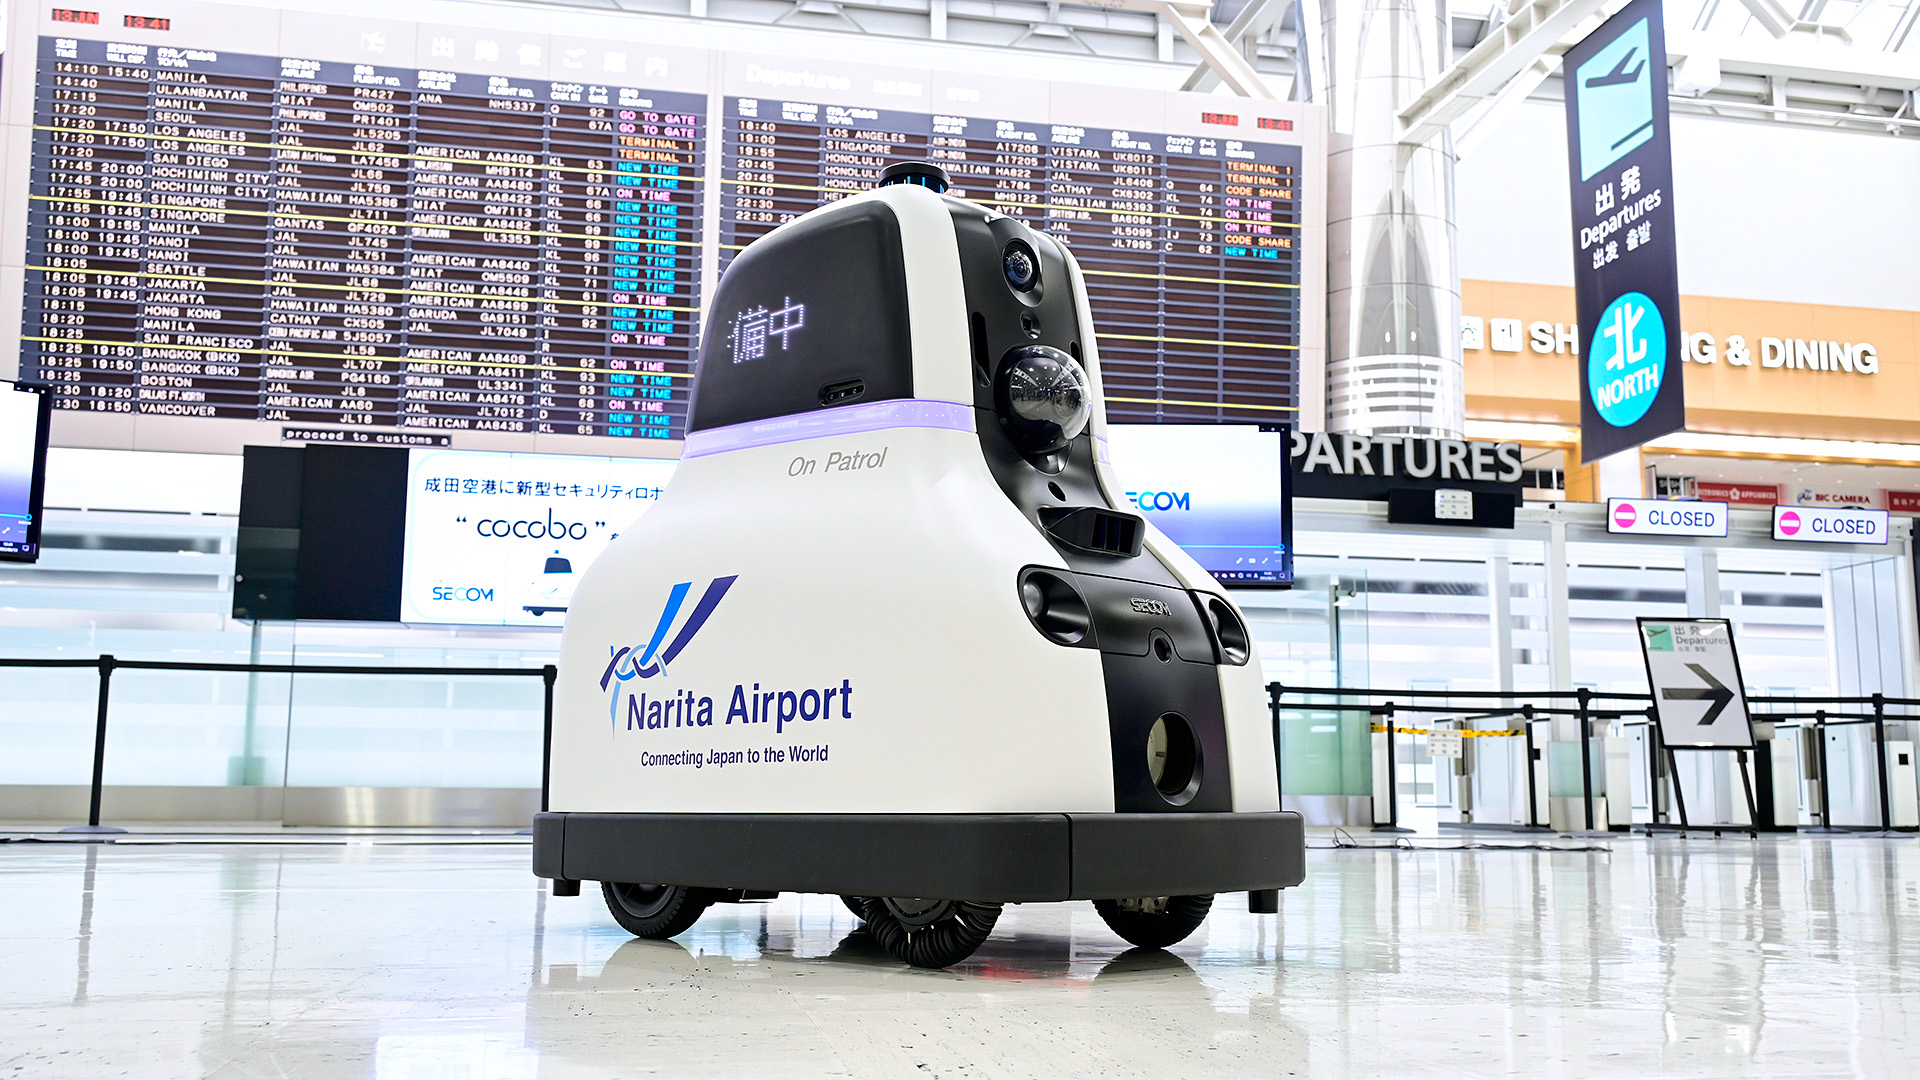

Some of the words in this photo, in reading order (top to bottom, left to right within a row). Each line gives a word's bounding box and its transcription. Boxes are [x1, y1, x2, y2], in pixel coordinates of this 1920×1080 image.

[54, 9, 73, 22] 13
[58, 63, 98, 74] 14:10
[109, 67, 148, 78] 15:40
[57, 76, 97, 88] 14:40
[157, 72, 207, 83] MANILA
[56, 90, 96, 102] 17:15
[157, 85, 247, 100] ULAANBAATAR
[156, 98, 206, 110] MANILA
[280, 96, 313, 106] MIAT
[55, 104, 96, 115] 17:20
[55, 118, 94, 129] 17:20
[156, 112, 196, 124] SEOUL
[620, 110, 636, 120] GO
[643, 112, 658, 122] TO
[665, 114, 695, 125] GATE
[106, 122, 145, 133] 17:50
[280, 123, 303, 132] JAL
[740, 121, 775, 132] 18:40
[155, 126, 179, 136] LOS
[188, 128, 246, 141] ANGELES
[740, 134, 775, 144] 19:00
[827, 128, 848, 138] LOS
[855, 131, 905, 142] ANGELES
[620, 136, 679, 150] TERMINAL
[827, 141, 890, 154] SINGAPORE
[416, 147, 479, 159] AMERICAN
[1052, 148, 1100, 158] VISTARA
[52, 160, 92, 171] 17:45
[154, 154, 178, 164] SAN
[187, 156, 228, 168] DIEGO
[826, 154, 884, 166] HONOLULU
[102, 163, 143, 175] 20:00
[618, 162, 642, 172] NEW
[649, 164, 678, 175] TIME
[1227, 162, 1279, 174] TERMINAL
[152, 167, 227, 181] HOCHIMINH
[236, 173, 269, 184] CITY
[51, 187, 90, 198] 17:55
[617, 188, 633, 198] ON
[640, 190, 670, 201] TIME
[737, 186, 773, 196] 21:40
[1051, 184, 1092, 194] CATHAY
[1226, 186, 1252, 196] CODE
[1260, 188, 1291, 199] SHARE
[1595, 164, 1641, 217] 出発
[102, 191, 142, 202] 19:45
[152, 194, 226, 208] SINGAPORE
[1051, 197, 1106, 208] HAWAIIAN
[276, 204, 299, 214] JAL
[414, 200, 446, 210] MIAT
[1226, 198, 1240, 206] ON
[1246, 199, 1272, 210] TIME
[49, 216, 89, 227] 18:00
[151, 209, 225, 223] SINGAPORE
[736, 211, 772, 221] 22:30
[1580, 188, 1662, 250] Departures
[100, 219, 140, 230] 19:55
[275, 218, 324, 230] QANTAS
[48, 230, 88, 240] 18:00
[100, 233, 139, 244] 19:45
[149, 236, 189, 248] HANOI
[148, 250, 188, 261] HANOI
[615, 255, 638, 264] NEW
[646, 257, 675, 267] TIME
[47, 257, 87, 268] 18:05
[273, 259, 338, 271] HAWAIIAN
[148, 264, 206, 276] SEATTLE
[46, 272, 86, 283] 18:05
[98, 275, 137, 286] 19:45
[147, 279, 205, 290] JAKARTA
[44, 300, 84, 310] 18:15
[613, 294, 629, 303] ON
[637, 295, 666, 306] TIME
[145, 306, 178, 316] HONG
[187, 309, 221, 319] KONG
[409, 309, 457, 319] GARUDA
[44, 314, 84, 324] 18:20
[270, 314, 320, 324] CATHAY
[582, 319, 597, 328] 92
[144, 320, 194, 331] MANILA
[727, 296, 803, 364] 備中
[43, 328, 83, 338] 18:25
[1604, 302, 1646, 371] 北
[144, 334, 169, 343] SAN
[178, 336, 253, 348] FRANCISCO
[94, 346, 134, 356] 19:50
[1726, 334, 1752, 367] &
[1760, 335, 1880, 375] DINING
[141, 376, 192, 387] BOSTON
[611, 374, 634, 383] NEW
[642, 376, 671, 386] TIME
[91, 387, 131, 398] 18:20
[268, 383, 291, 392] JAL
[1597, 363, 1659, 411] NORTH
[90, 401, 130, 411] 18:50
[267, 396, 332, 408] AMERICAN
[140, 404, 215, 416] VANCOUVER
[580, 412, 593, 421] 72
[286, 431, 344, 442] proceed
[354, 433, 369, 442] to
[377, 435, 433, 445] customs
[788, 456, 816, 477] On
[824, 446, 888, 473] Patrol
[1290, 431, 1523, 483] PARTURES
[1125, 491, 1190, 512] ECOM
[1815, 493, 1830, 502] BIC
[1832, 494, 1871, 504] CAMERA
[1649, 509, 1715, 528] CLOSED
[1812, 517, 1876, 536] CLOSED
[433, 586, 494, 602] SECOM
[1676, 636, 1729, 646] Departures
[627, 689, 714, 731] Narita
[725, 679, 853, 733] Airport
[641, 749, 703, 769] Connecting
[706, 748, 743, 768] Japan
[747, 748, 760, 764] to
[764, 746, 785, 763] the
[789, 745, 829, 762] World
